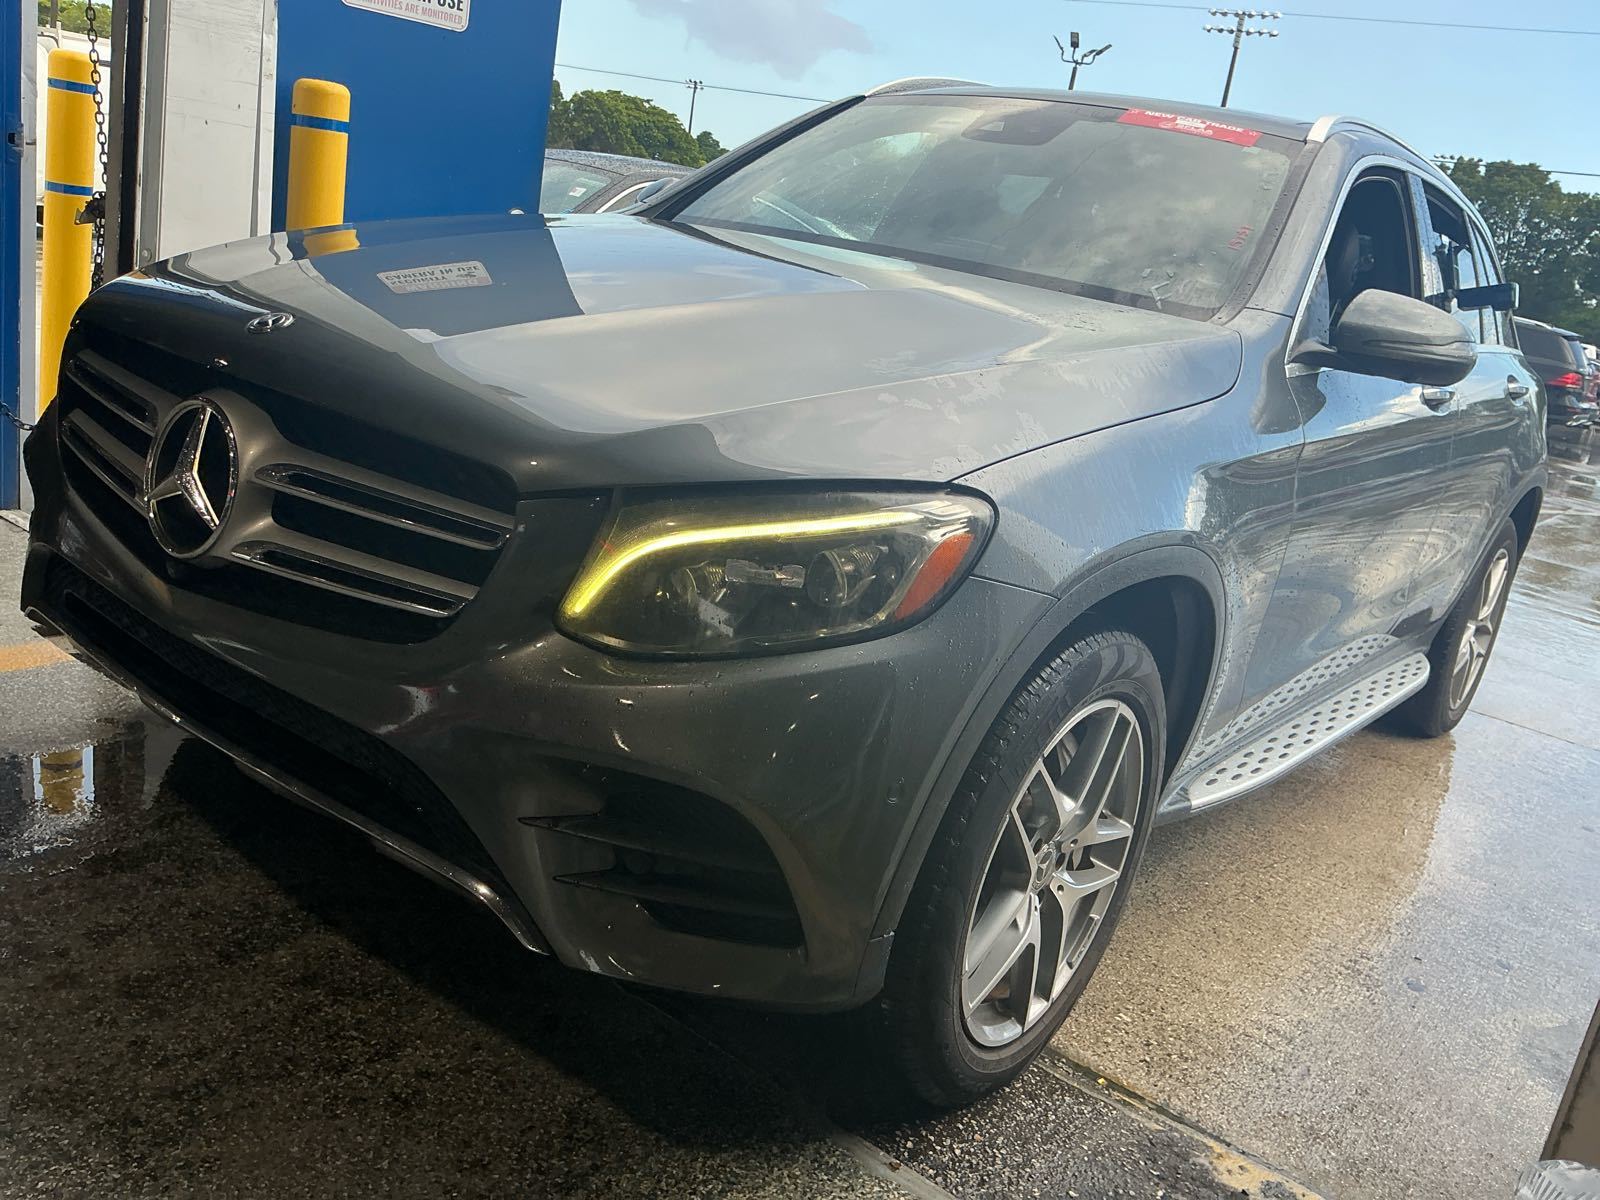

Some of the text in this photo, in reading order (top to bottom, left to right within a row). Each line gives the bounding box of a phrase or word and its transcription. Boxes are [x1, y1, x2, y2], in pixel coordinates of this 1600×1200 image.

[366, 0, 463, 24] TIVITIES ARE MONITORED
[1145, 110, 1175, 119] NEW
[1204, 120, 1245, 133] TRADE
